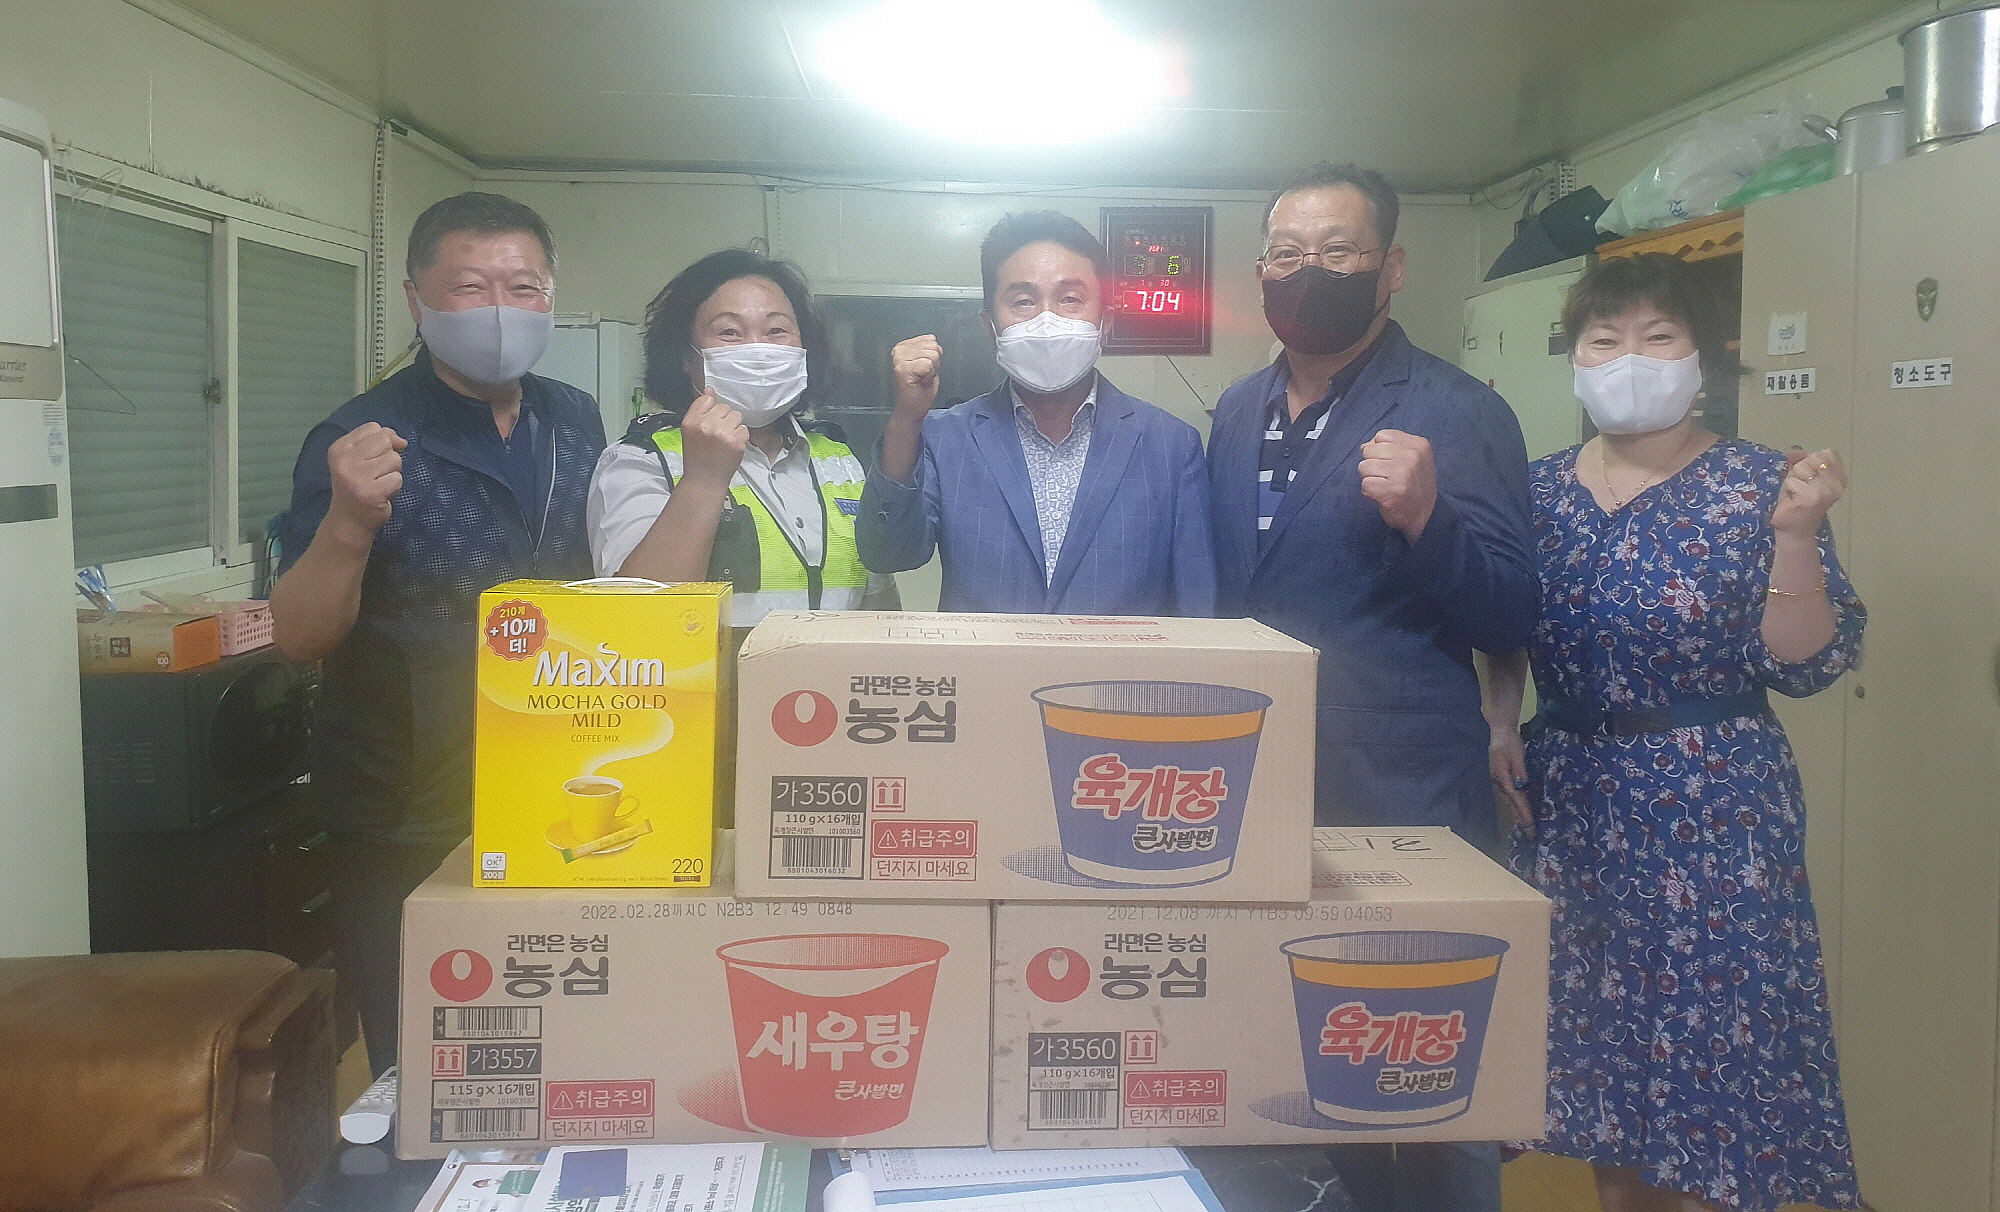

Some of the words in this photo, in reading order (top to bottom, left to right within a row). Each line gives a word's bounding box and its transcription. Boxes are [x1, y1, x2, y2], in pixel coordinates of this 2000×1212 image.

[1167, 255, 1179, 275] 6
[1136, 291, 1180, 312] 7:04
[1894, 364, 1951, 384] 청소도구
[500, 606, 526, 618] 210개
[490, 618, 536, 638] +10개
[509, 638, 527, 653] 더!
[533, 642, 664, 686] Maxim
[850, 676, 912, 696] 라면은
[915, 676, 956, 696] 농심
[527, 694, 605, 710] MOCHA
[611, 694, 667, 710] GOLD
[571, 714, 622, 728] MILD
[845, 698, 956, 744] 농심
[571, 734, 602, 742] COFFEE
[604, 734, 620, 742] MIX
[776, 781, 863, 807] 가3560
[1074, 754, 1227, 820] 육개장
[786, 814, 806, 823] 110
[900, 827, 970, 848] 취급주의
[1132, 826, 1215, 850] 큰사발면
[672, 858, 704, 874] 220
[876, 860, 921, 877] 던지지
[926, 860, 970, 878] 마세요
[716, 902, 754, 917] N2B3
[765, 902, 808, 916] 12:49
[818, 901, 853, 916] 0848
[1107, 904, 1200, 920] 2021.12.08
[1205, 906, 1238, 920] 까지
[1294, 906, 1339, 921] 09:59
[1344, 906, 1393, 922] 04053
[507, 934, 566, 954] 라면은
[570, 934, 609, 954] 농심
[1104, 933, 1164, 953] 라면은
[1168, 933, 1208, 953] 농심
[502, 956, 610, 998] 농심
[1100, 956, 1208, 1000] 농심
[746, 1010, 920, 1071] 새우탕
[1320, 1004, 1466, 1064] 육개장
[471, 1048, 538, 1071] 가3557
[1033, 1038, 1116, 1062] 가3560
[1043, 1069, 1062, 1078] 110
[1376, 1069, 1455, 1093] 큰사발면
[450, 1084, 473, 1095] 115
[576, 1088, 648, 1108] 취급주의
[834, 1080, 904, 1100] 큰사발면
[1152, 1078, 1220, 1098] 취급주의
[1130, 1108, 1174, 1124] 던지지
[1176, 1108, 1220, 1124] 마세요
[552, 1120, 598, 1137] 던지지
[602, 1120, 648, 1136] 마세요
